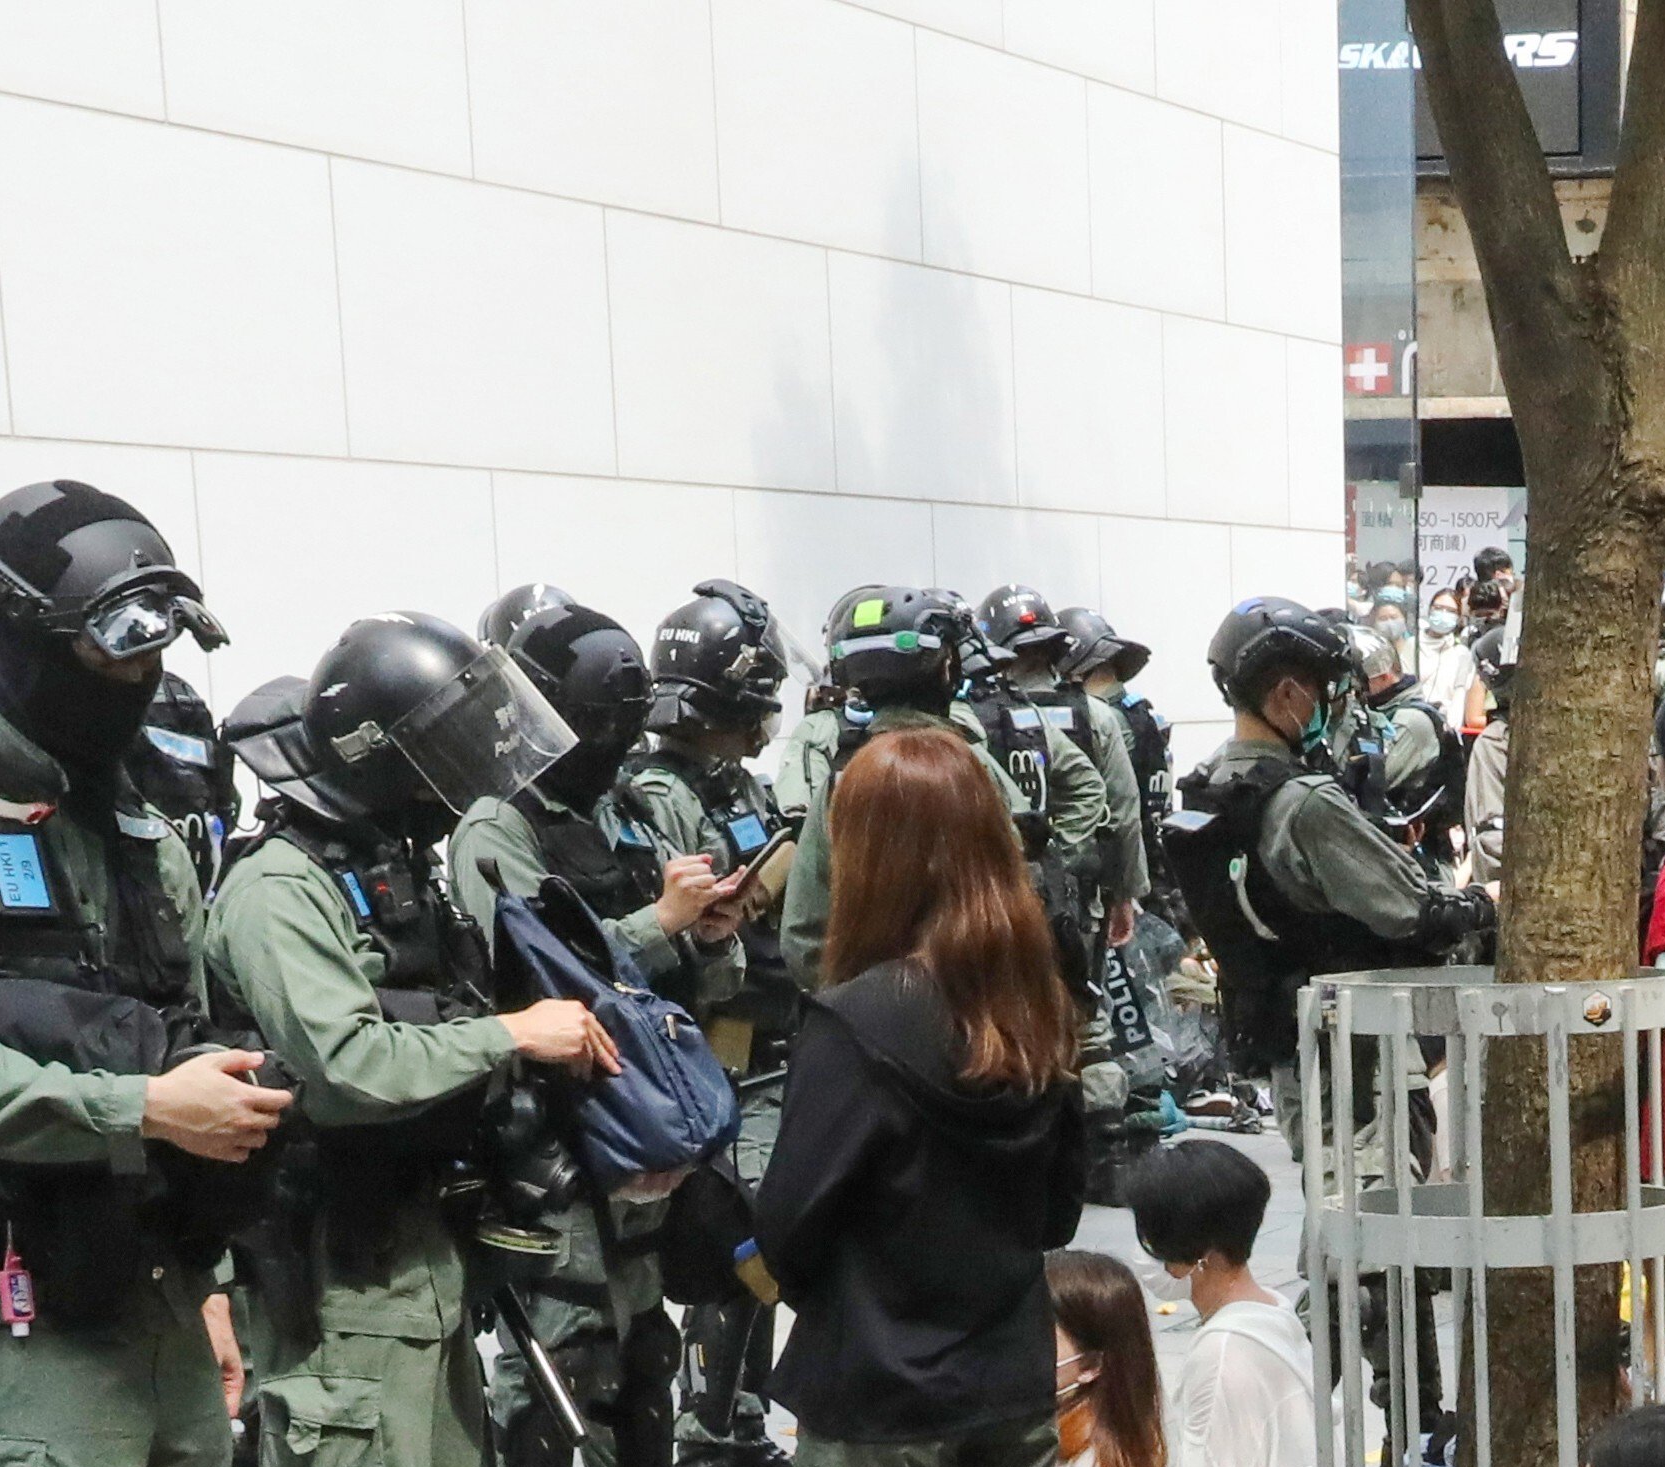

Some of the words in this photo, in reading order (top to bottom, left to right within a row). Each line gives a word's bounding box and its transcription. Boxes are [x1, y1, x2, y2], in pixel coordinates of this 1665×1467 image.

[658, 627, 674, 642] EU
[675, 628, 701, 645] HKI
[0, 852, 16, 878] HKI
[20, 860, 36, 880] 2/9
[5, 881, 22, 903] EU
